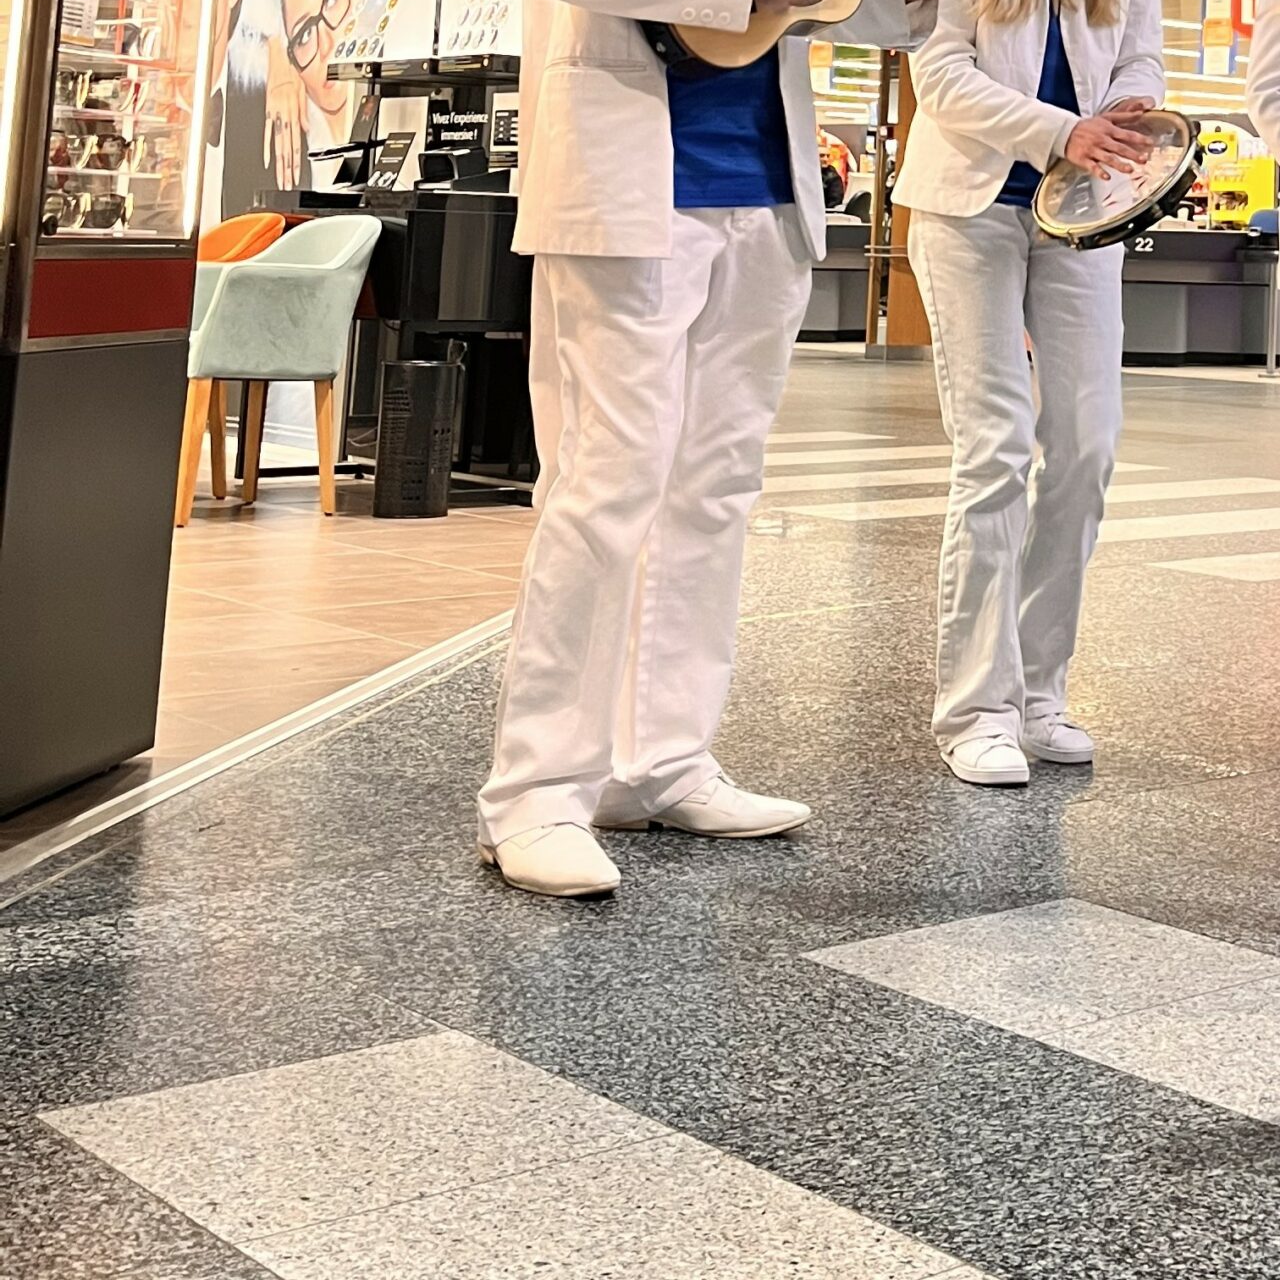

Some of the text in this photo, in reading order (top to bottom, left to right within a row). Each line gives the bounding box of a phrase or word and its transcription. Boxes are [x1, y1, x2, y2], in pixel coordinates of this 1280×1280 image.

[432, 112, 450, 124] Vivez
[441, 129, 473, 141] immersive
[1134, 237, 1154, 251] 22
